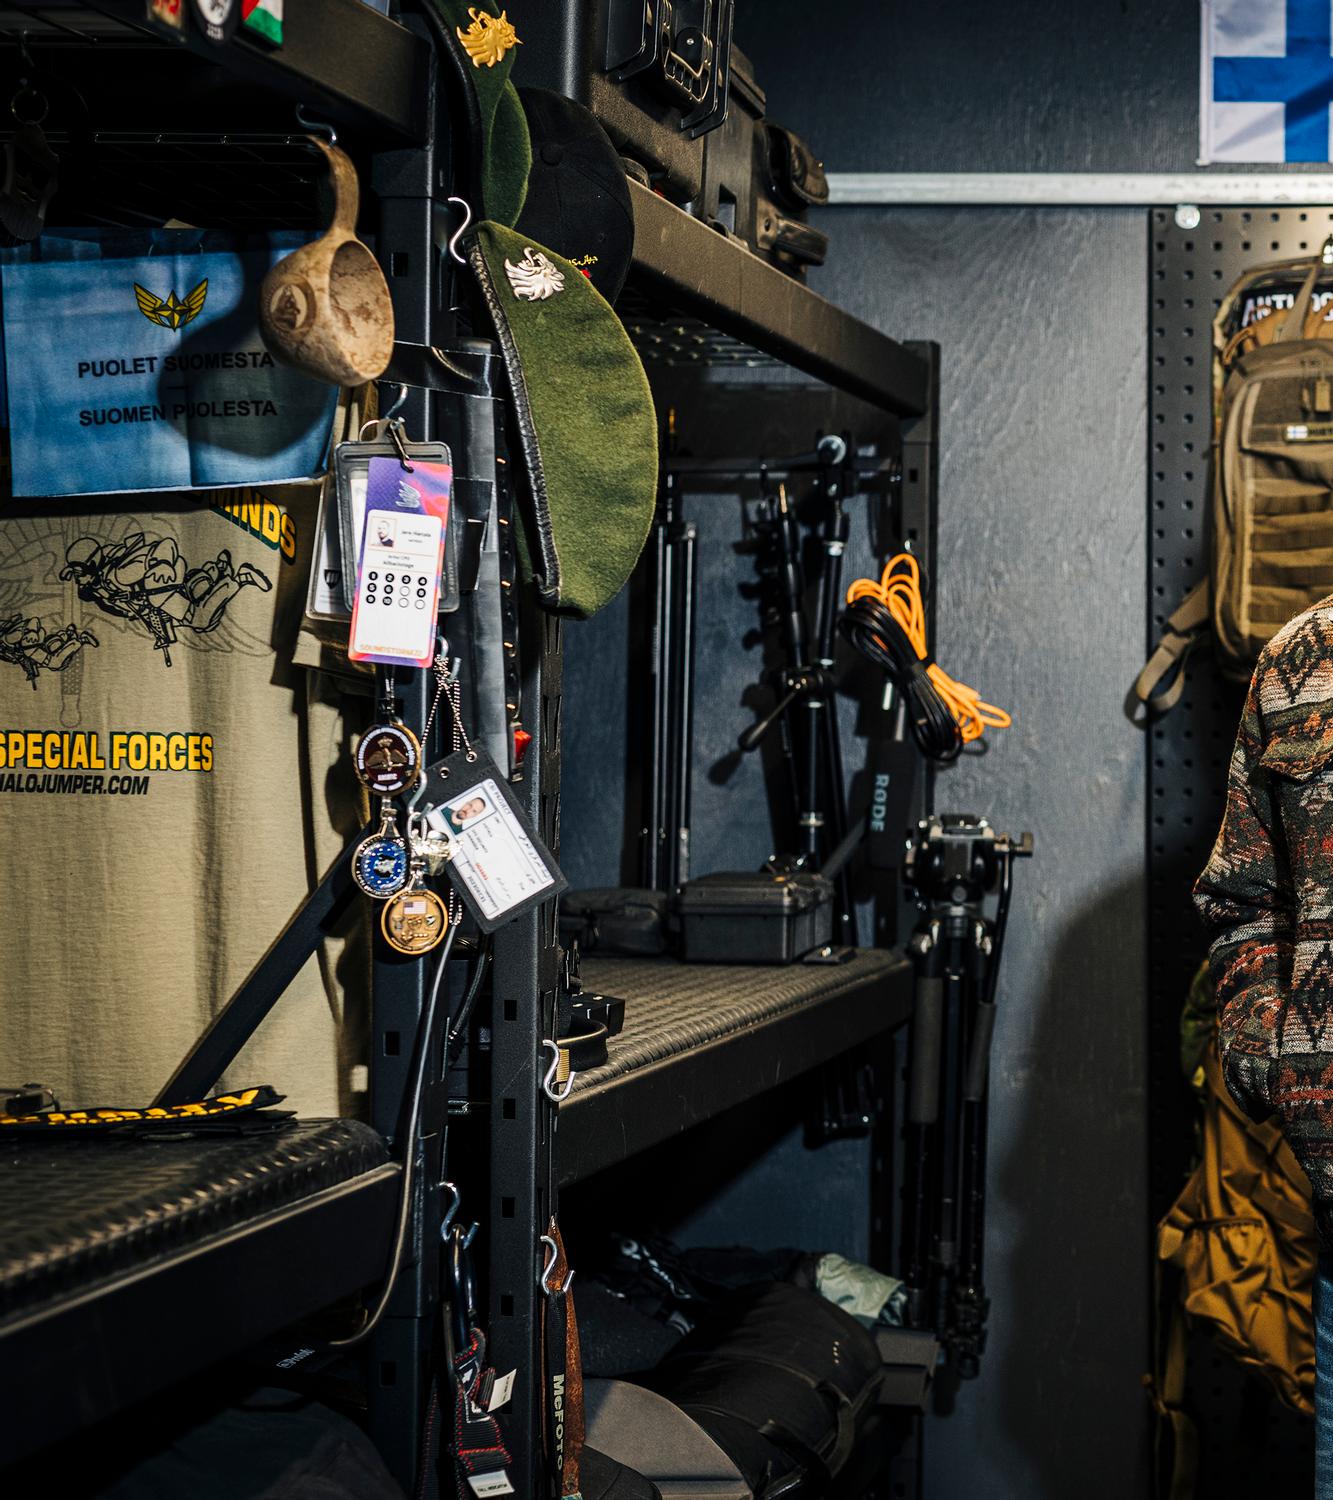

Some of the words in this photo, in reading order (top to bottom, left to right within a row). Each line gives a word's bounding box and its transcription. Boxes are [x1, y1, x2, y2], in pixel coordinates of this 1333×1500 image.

[78, 356, 158, 378] PUOLET
[164, 352, 275, 373] SUOMESTA
[79, 404, 166, 427] SUOMEN
[173, 400, 278, 420] PUOLESTA
[109, 731, 214, 772] FORCES
[0, 773, 150, 795] ALOJUMPER.COM
